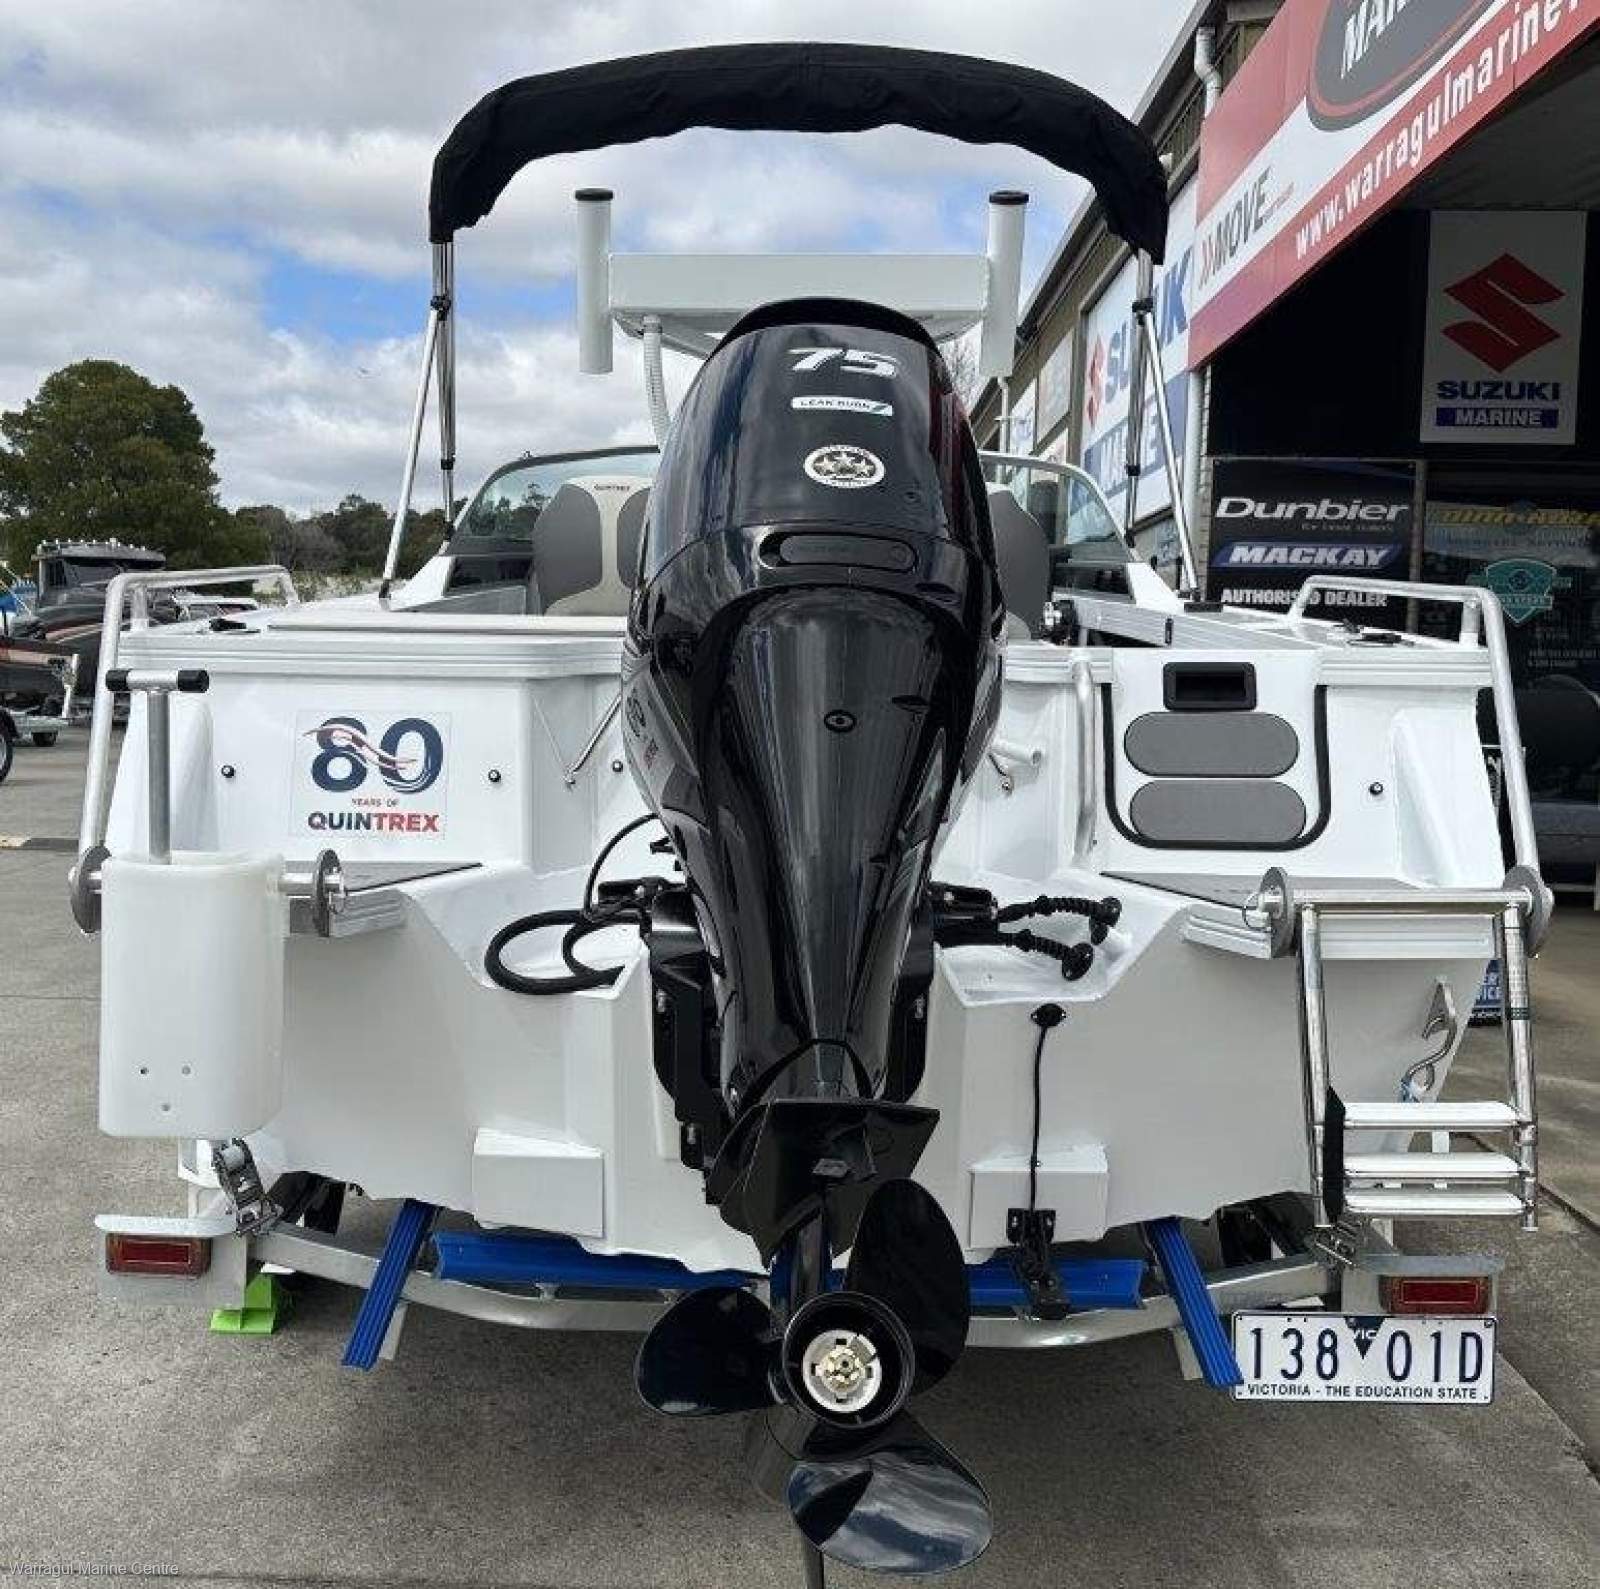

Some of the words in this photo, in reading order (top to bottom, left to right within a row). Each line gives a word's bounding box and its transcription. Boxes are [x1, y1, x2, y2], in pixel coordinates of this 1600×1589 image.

[787, 347, 897, 379] 75
[1437, 380, 1560, 399] SUZUKI
[1455, 409, 1543, 425] MARINE
[1216, 498, 1409, 520] Dunbier
[1229, 546, 1391, 565] MACKAY
[1220, 589, 1320, 605] AUTHORISD
[1324, 591, 1388, 607] DEALER
[311, 716, 444, 794] 80
[351, 798, 382, 807] YEARS
[386, 798, 399, 807] OF
[307, 811, 440, 833] QUINTREX
[1251, 1327, 1340, 1381] 138
[1247, 1383, 1311, 1396] VICTORIA
[1325, 1385, 1351, 1398] THE
[1355, 1386, 1433, 1399] EDUCATION
[1437, 1386, 1477, 1399] STATE
